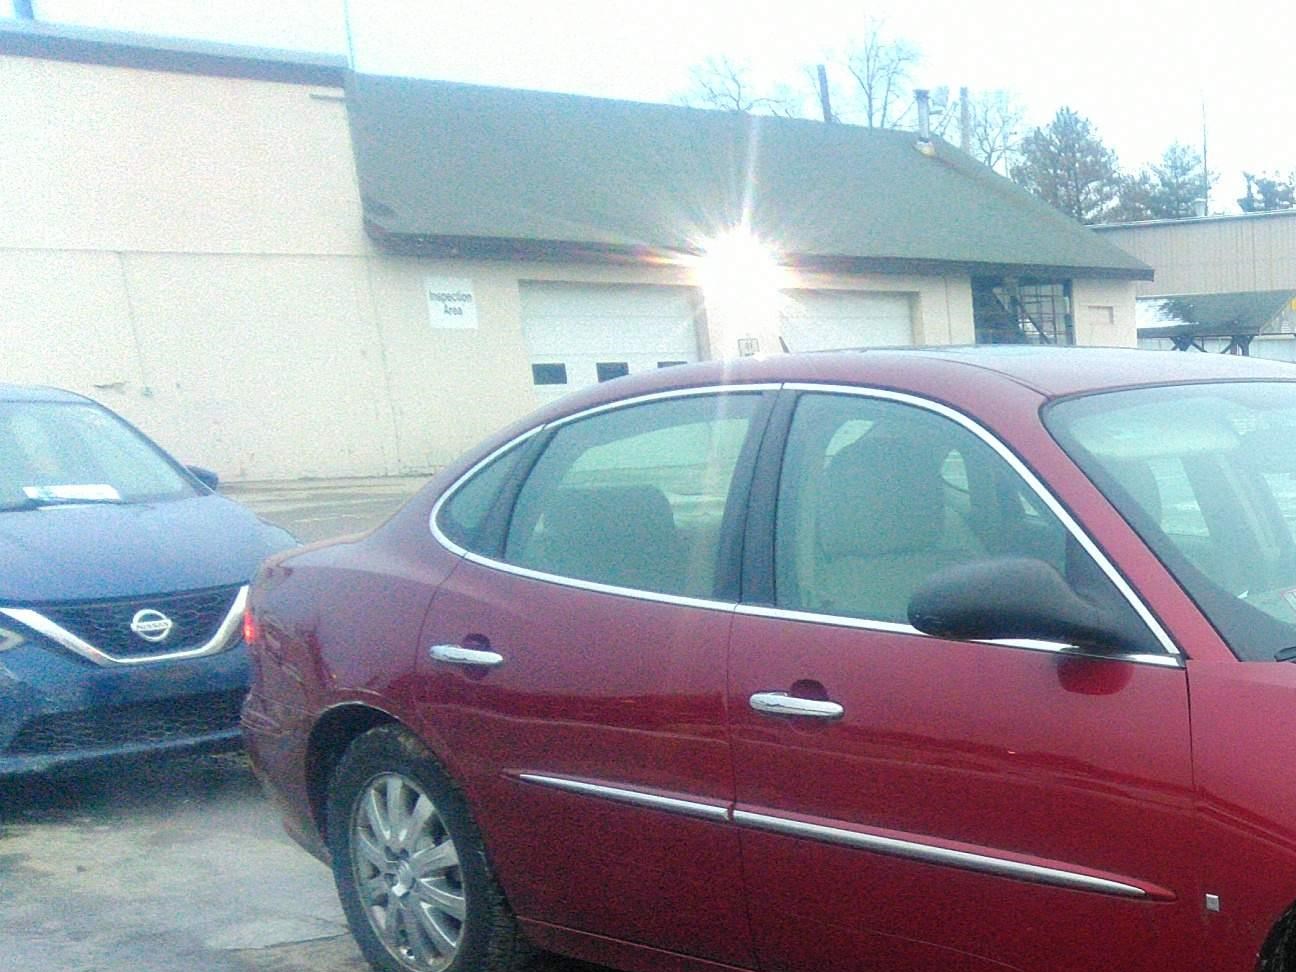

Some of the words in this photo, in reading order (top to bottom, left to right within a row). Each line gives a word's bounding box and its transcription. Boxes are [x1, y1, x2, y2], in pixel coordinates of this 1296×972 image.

[428, 289, 473, 304] Inspection
[443, 304, 463, 316] Area
[136, 621, 169, 631] NISSAN
